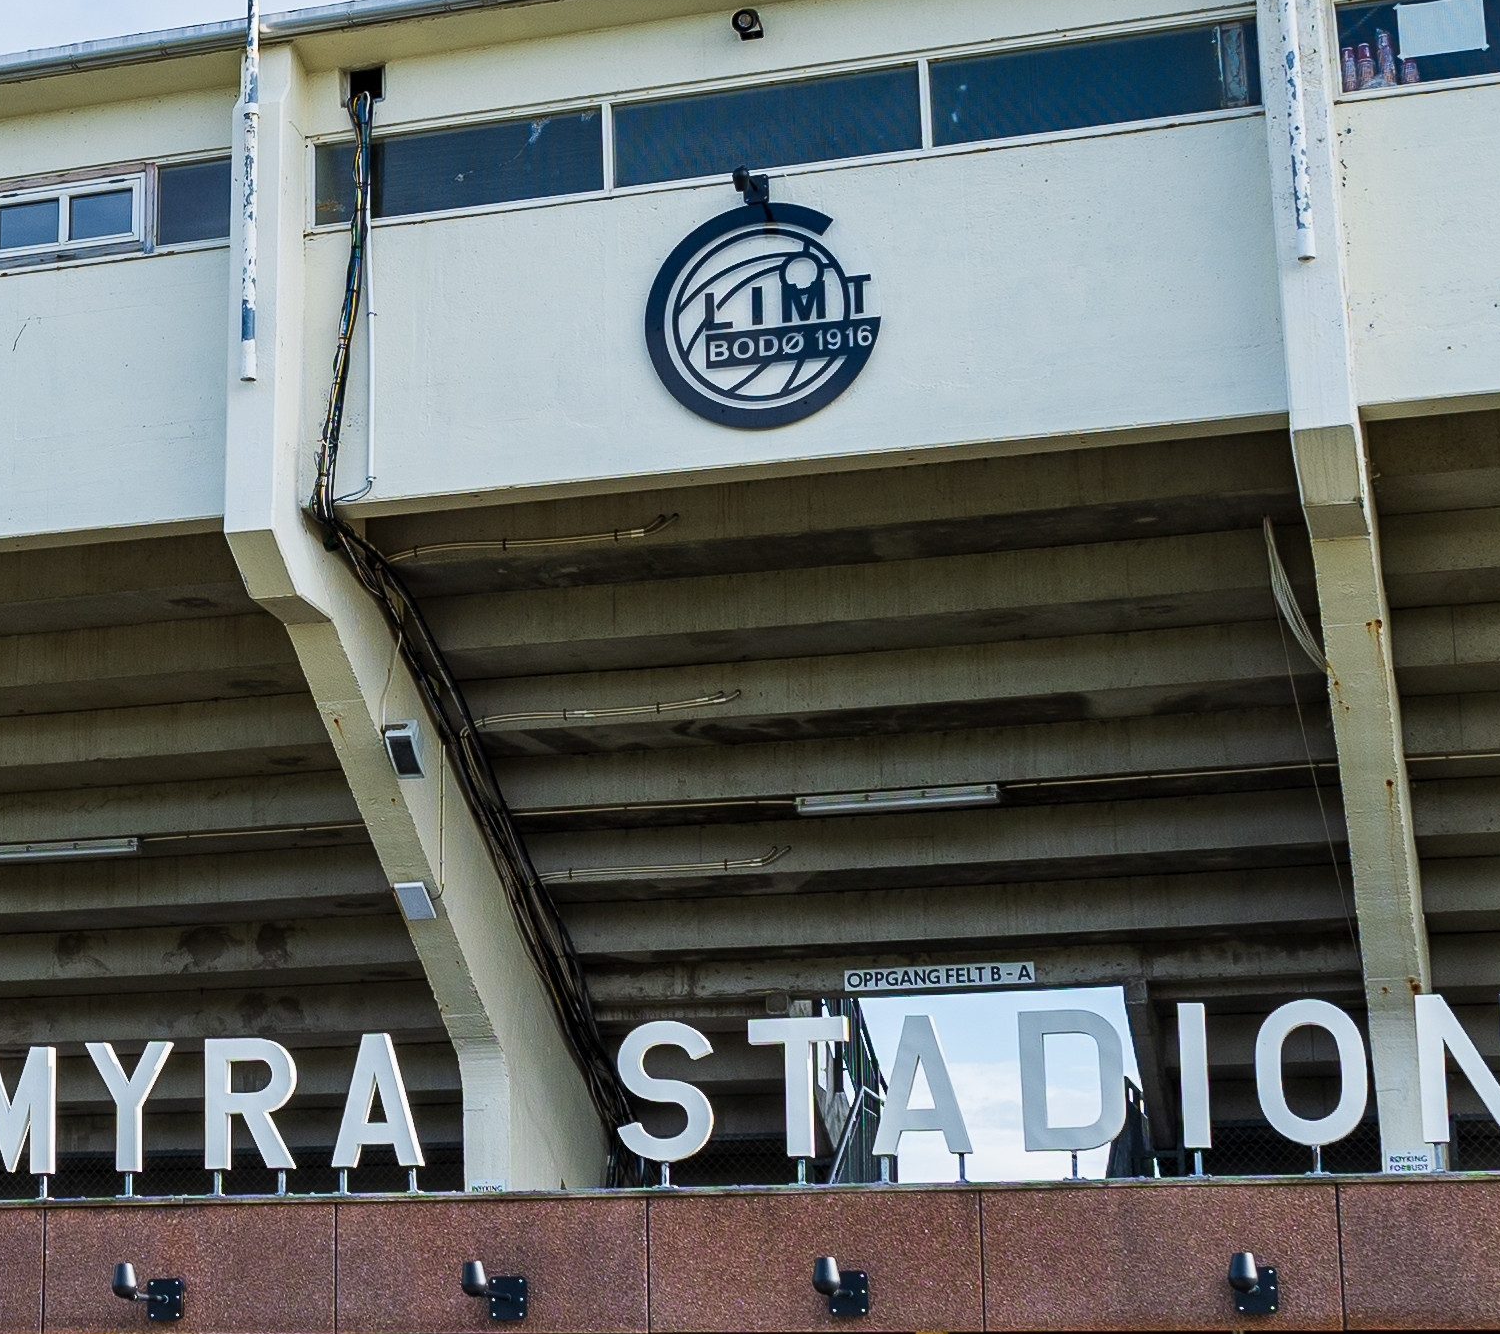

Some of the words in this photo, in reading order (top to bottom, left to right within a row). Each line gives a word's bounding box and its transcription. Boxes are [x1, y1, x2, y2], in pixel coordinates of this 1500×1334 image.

[708, 331, 805, 363] BODØ
[815, 324, 873, 352] 1916
[846, 968, 942, 989] OPPGANG
[945, 966, 985, 985] FELT
[990, 965, 1002, 983] B
[1017, 964, 1033, 982] A
